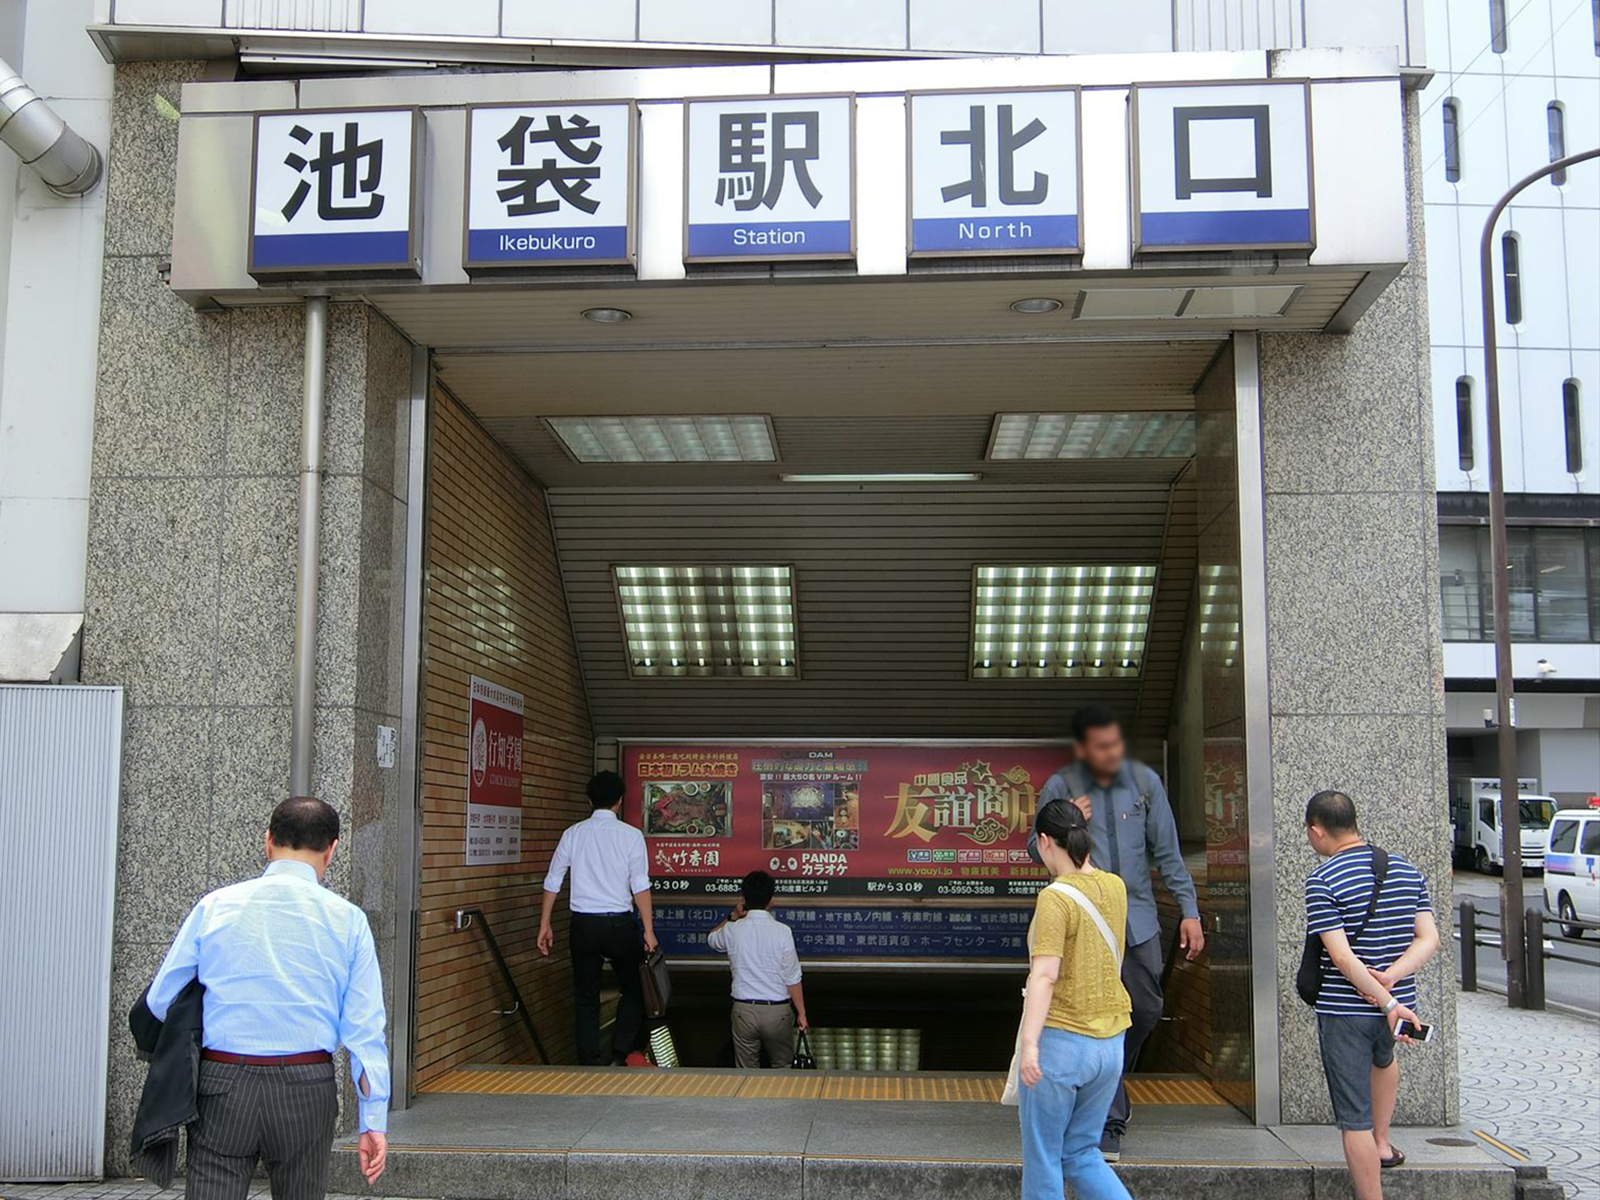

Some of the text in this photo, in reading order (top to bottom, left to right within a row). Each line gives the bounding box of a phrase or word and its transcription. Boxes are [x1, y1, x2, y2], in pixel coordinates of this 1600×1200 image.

[281, 104, 1272, 221] 池袋駅北口
[499, 221, 1033, 251] Ikebukuro Station North
[802, 853, 847, 863] PANDA
[802, 864, 848, 876] カラオケ
[888, 866, 953, 876] www.youyi.jp
[650, 880, 689, 890] ら30秒
[938, 886, 995, 895] 03-5950-3588
